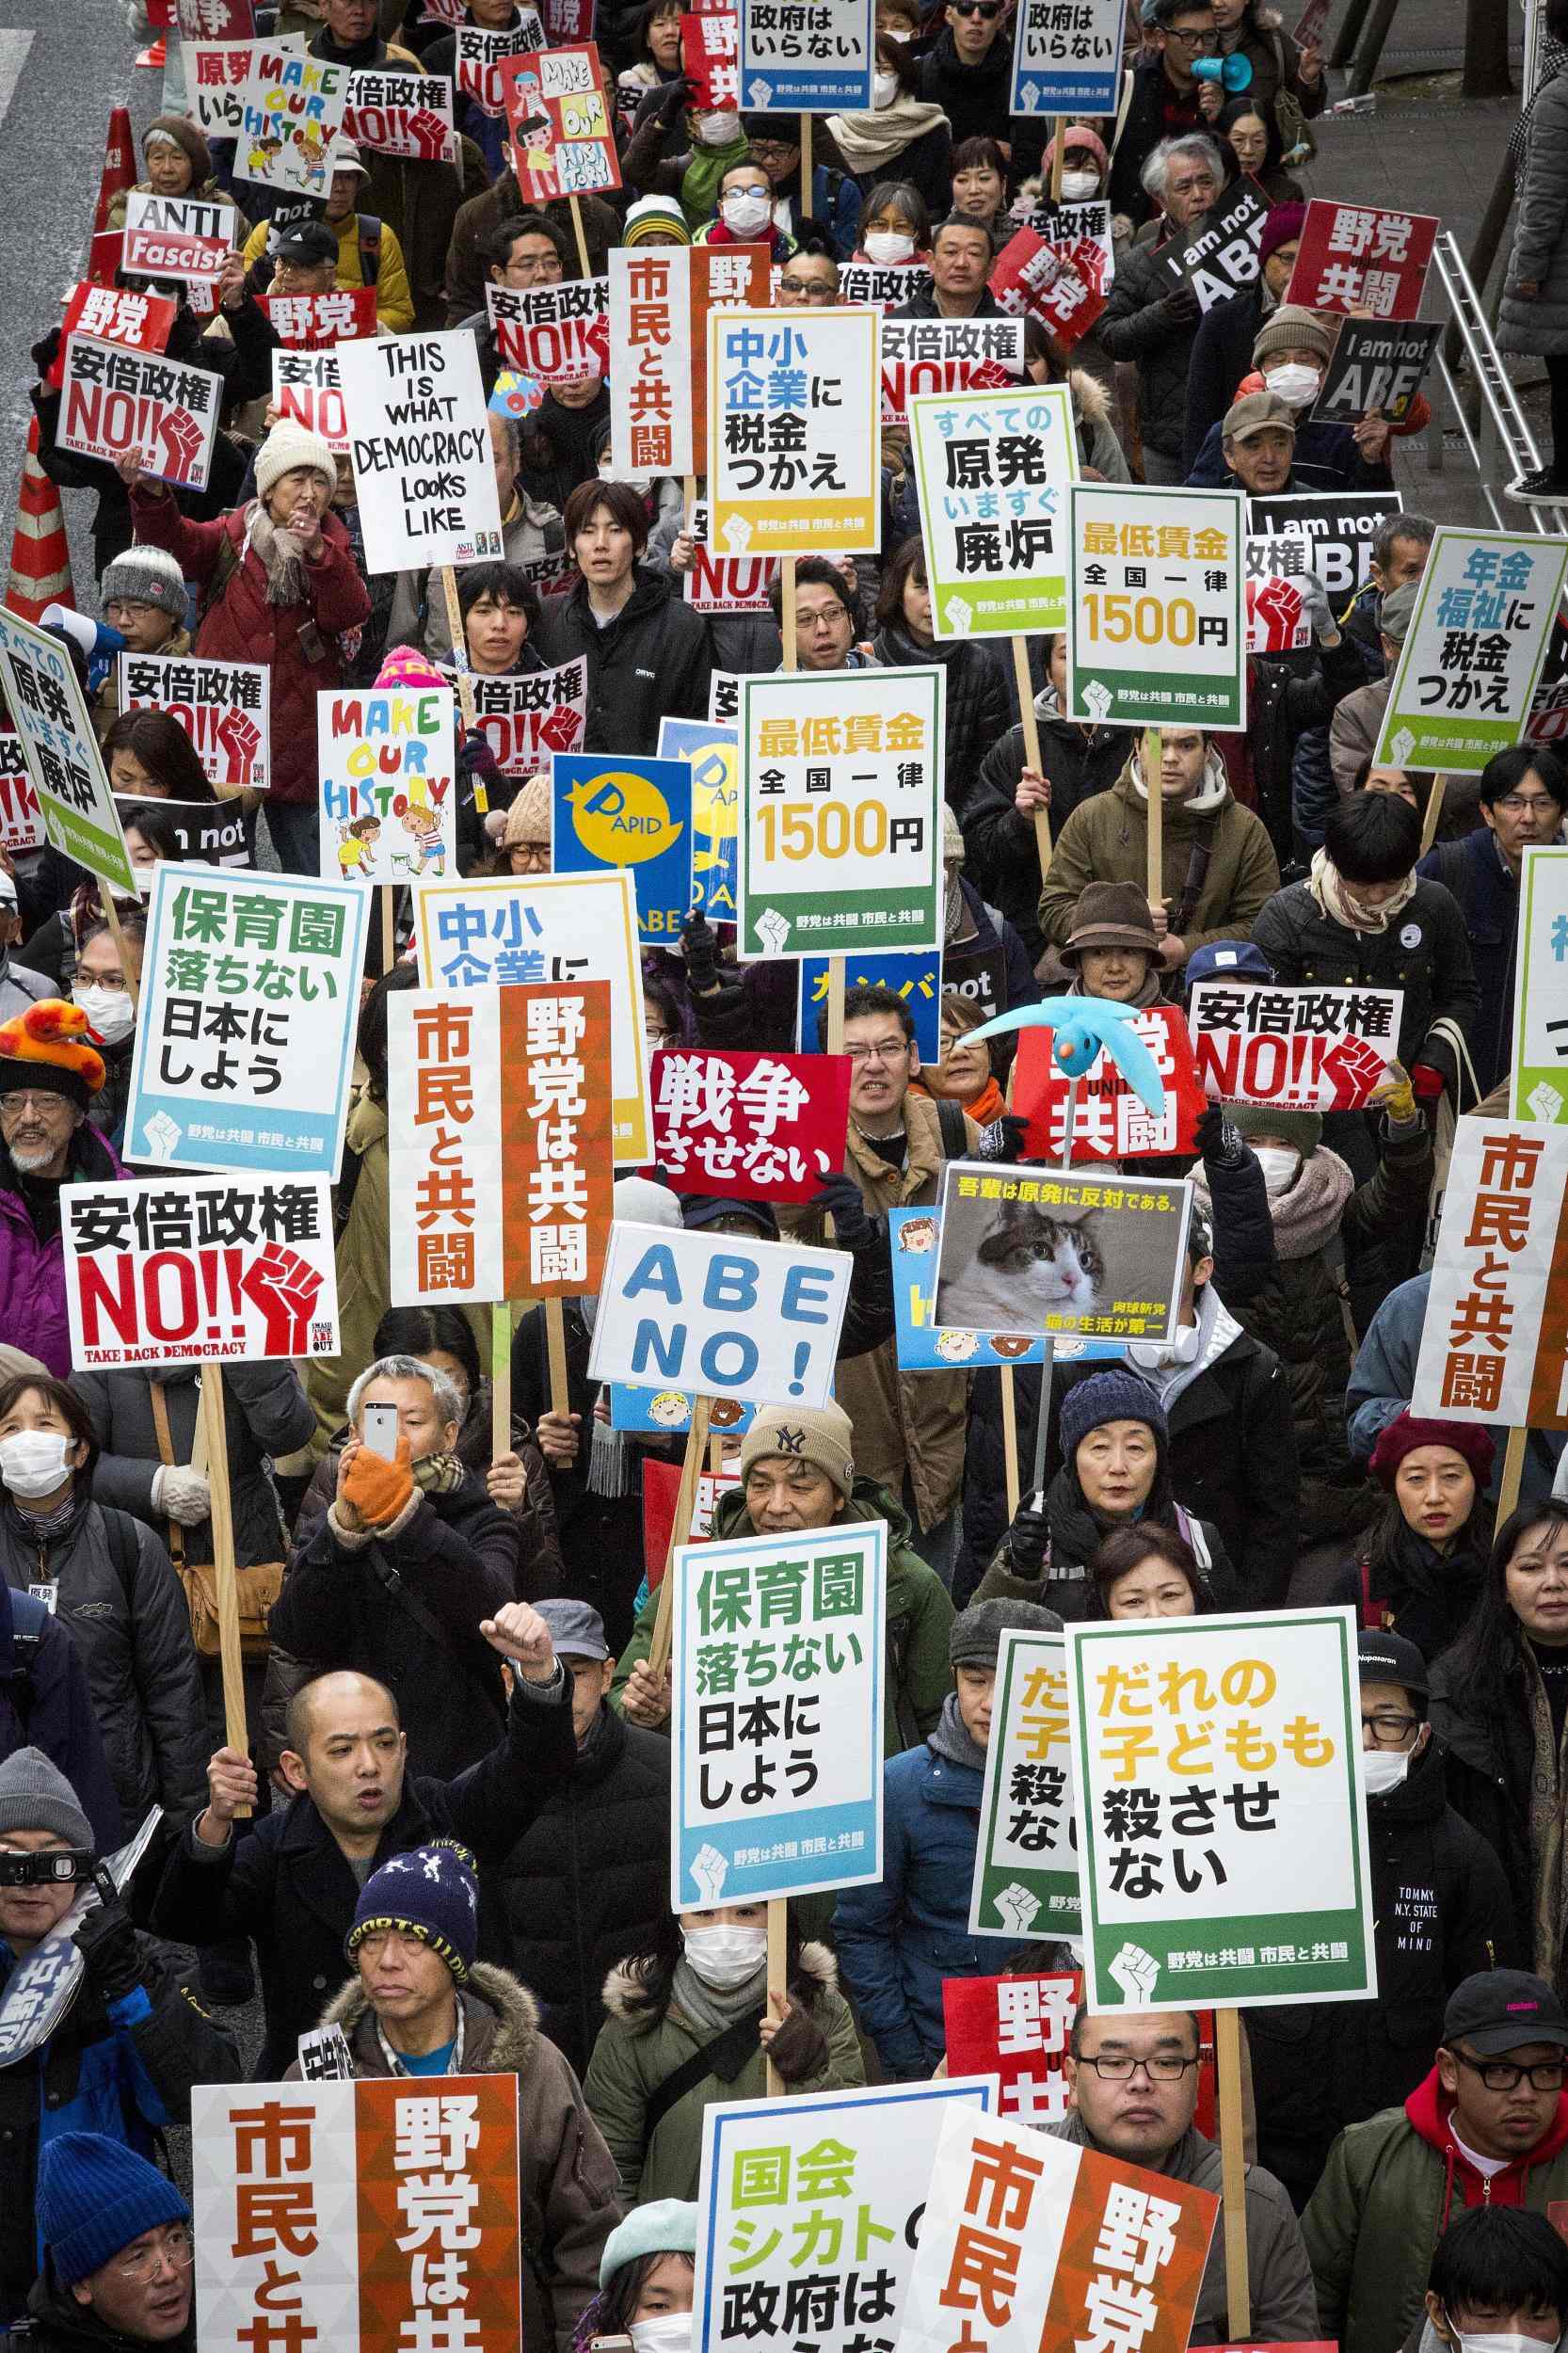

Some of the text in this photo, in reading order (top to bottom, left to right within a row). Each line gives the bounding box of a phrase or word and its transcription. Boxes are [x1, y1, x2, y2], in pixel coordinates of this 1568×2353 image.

[750, 6, 832, 30] 政府は
[1028, 4, 1093, 30] 政府は
[751, 34, 861, 58] いらない
[1027, 35, 1112, 59] いらない
[259, 54, 340, 95] MAKE
[543, 59, 591, 91] MAKE
[245, 104, 338, 144] HISTORY
[265, 88, 326, 120] OUR
[565, 95, 603, 136] OUR
[138, 200, 222, 239] ANTI
[1183, 230, 1222, 266] am
[1220, 193, 1259, 235] not
[1327, 208, 1413, 263] 野党
[131, 235, 226, 271] Fascist
[1315, 263, 1401, 317] 共闘
[75, 286, 149, 344] 野党
[269, 293, 358, 340] 野党
[377, 342, 446, 377] THIS
[494, 318, 588, 375] NO!!
[626, 256, 673, 469] 市民と共闘
[726, 327, 808, 368] 中小
[881, 324, 1017, 360] 安倍政権
[1358, 341, 1393, 359] am
[1393, 339, 1429, 360] not
[71, 344, 212, 414] 安倍政権
[407, 376, 434, 400] IS
[725, 369, 842, 410] 企業に
[65, 379, 165, 460] NO!!
[384, 396, 458, 425] WHAT
[933, 405, 1052, 438] すべての
[66, 438, 86, 452] TAKE
[353, 427, 485, 475] DEMOCRACY
[725, 413, 808, 455] 税金
[727, 453, 846, 492] つかえ
[944, 434, 1048, 490] 原発
[401, 471, 467, 503] LOOKS
[943, 487, 1060, 520] いますぐ
[405, 507, 466, 537] LIKE
[1082, 520, 1228, 562] 最低賃金
[1283, 520, 1330, 536] am
[1337, 514, 1386, 535] not
[953, 518, 1054, 575] 廃炉
[1463, 547, 1535, 592] 年金
[1083, 563, 1228, 593] 全国一律
[1082, 593, 1229, 647] 1500円
[1436, 586, 1535, 631] 福祉に
[1439, 631, 1512, 673] 税金
[8, 650, 76, 736] 原発
[127, 660, 262, 710] 安倍政権
[444, 664, 583, 715] 倍政権
[1417, 673, 1511, 713] つかえ
[331, 695, 441, 739] MAKE
[758, 712, 925, 760] 最低賃金
[346, 740, 429, 777] OUR
[759, 760, 923, 795] 全国一律
[324, 776, 451, 819] HISTORY
[200, 819, 246, 846] not
[756, 798, 924, 862] 1500円
[170, 886, 347, 958] 保育園
[437, 899, 544, 952] 中小
[795, 909, 924, 929] 野党は共闘 市民と共闘
[164, 948, 339, 1002] 落ちない
[162, 996, 290, 1047] 日本に
[1196, 990, 1395, 1038] 安倍政権
[159, 1044, 283, 1096] しよう
[1194, 1032, 1328, 1100] NO!!
[653, 1052, 810, 1137] 戦争
[525, 996, 587, 1285] 野党は共闘
[1048, 1091, 1177, 1156] 共闘
[412, 1002, 476, 1294] 市民と共闘
[654, 1129, 831, 1184] させない
[957, 1176, 1177, 1213] 吾輩は原発に反対である。
[71, 1184, 321, 1255] 安倍政権
[621, 1243, 836, 1325] ABE
[1439, 1133, 1546, 1413] 市民と共闘
[76, 1247, 247, 1347] NO!!
[84, 1341, 247, 1364] TAKE BACK DEMOCRACY
[630, 1318, 812, 1397] NO!
[696, 1551, 865, 1638] 保育園
[696, 1628, 865, 1697] 落ちない
[1096, 1658, 1277, 1718] だれの
[698, 1693, 822, 1755] 日本に
[1099, 1715, 1336, 1783] 子どもも
[698, 1749, 820, 1811] しよう
[1102, 1779, 1281, 1843] 殺させ
[733, 1831, 865, 1867] 野党は共闘 市民と共闘
[1107, 1846, 1228, 1899] ない
[1399, 1886, 1434, 1902] TOMMY
[1395, 1902, 1438, 1918] N.Y. STATE
[1410, 1920, 1422, 1934] OF
[1167, 1942, 1349, 1971] 野党は共闘 市民と共闘
[1398, 1935, 1432, 1950] MIND
[731, 2138, 857, 2209] 国会
[1088, 2182, 1182, 2353] 野党
[721, 2268, 896, 2341] 政府は
